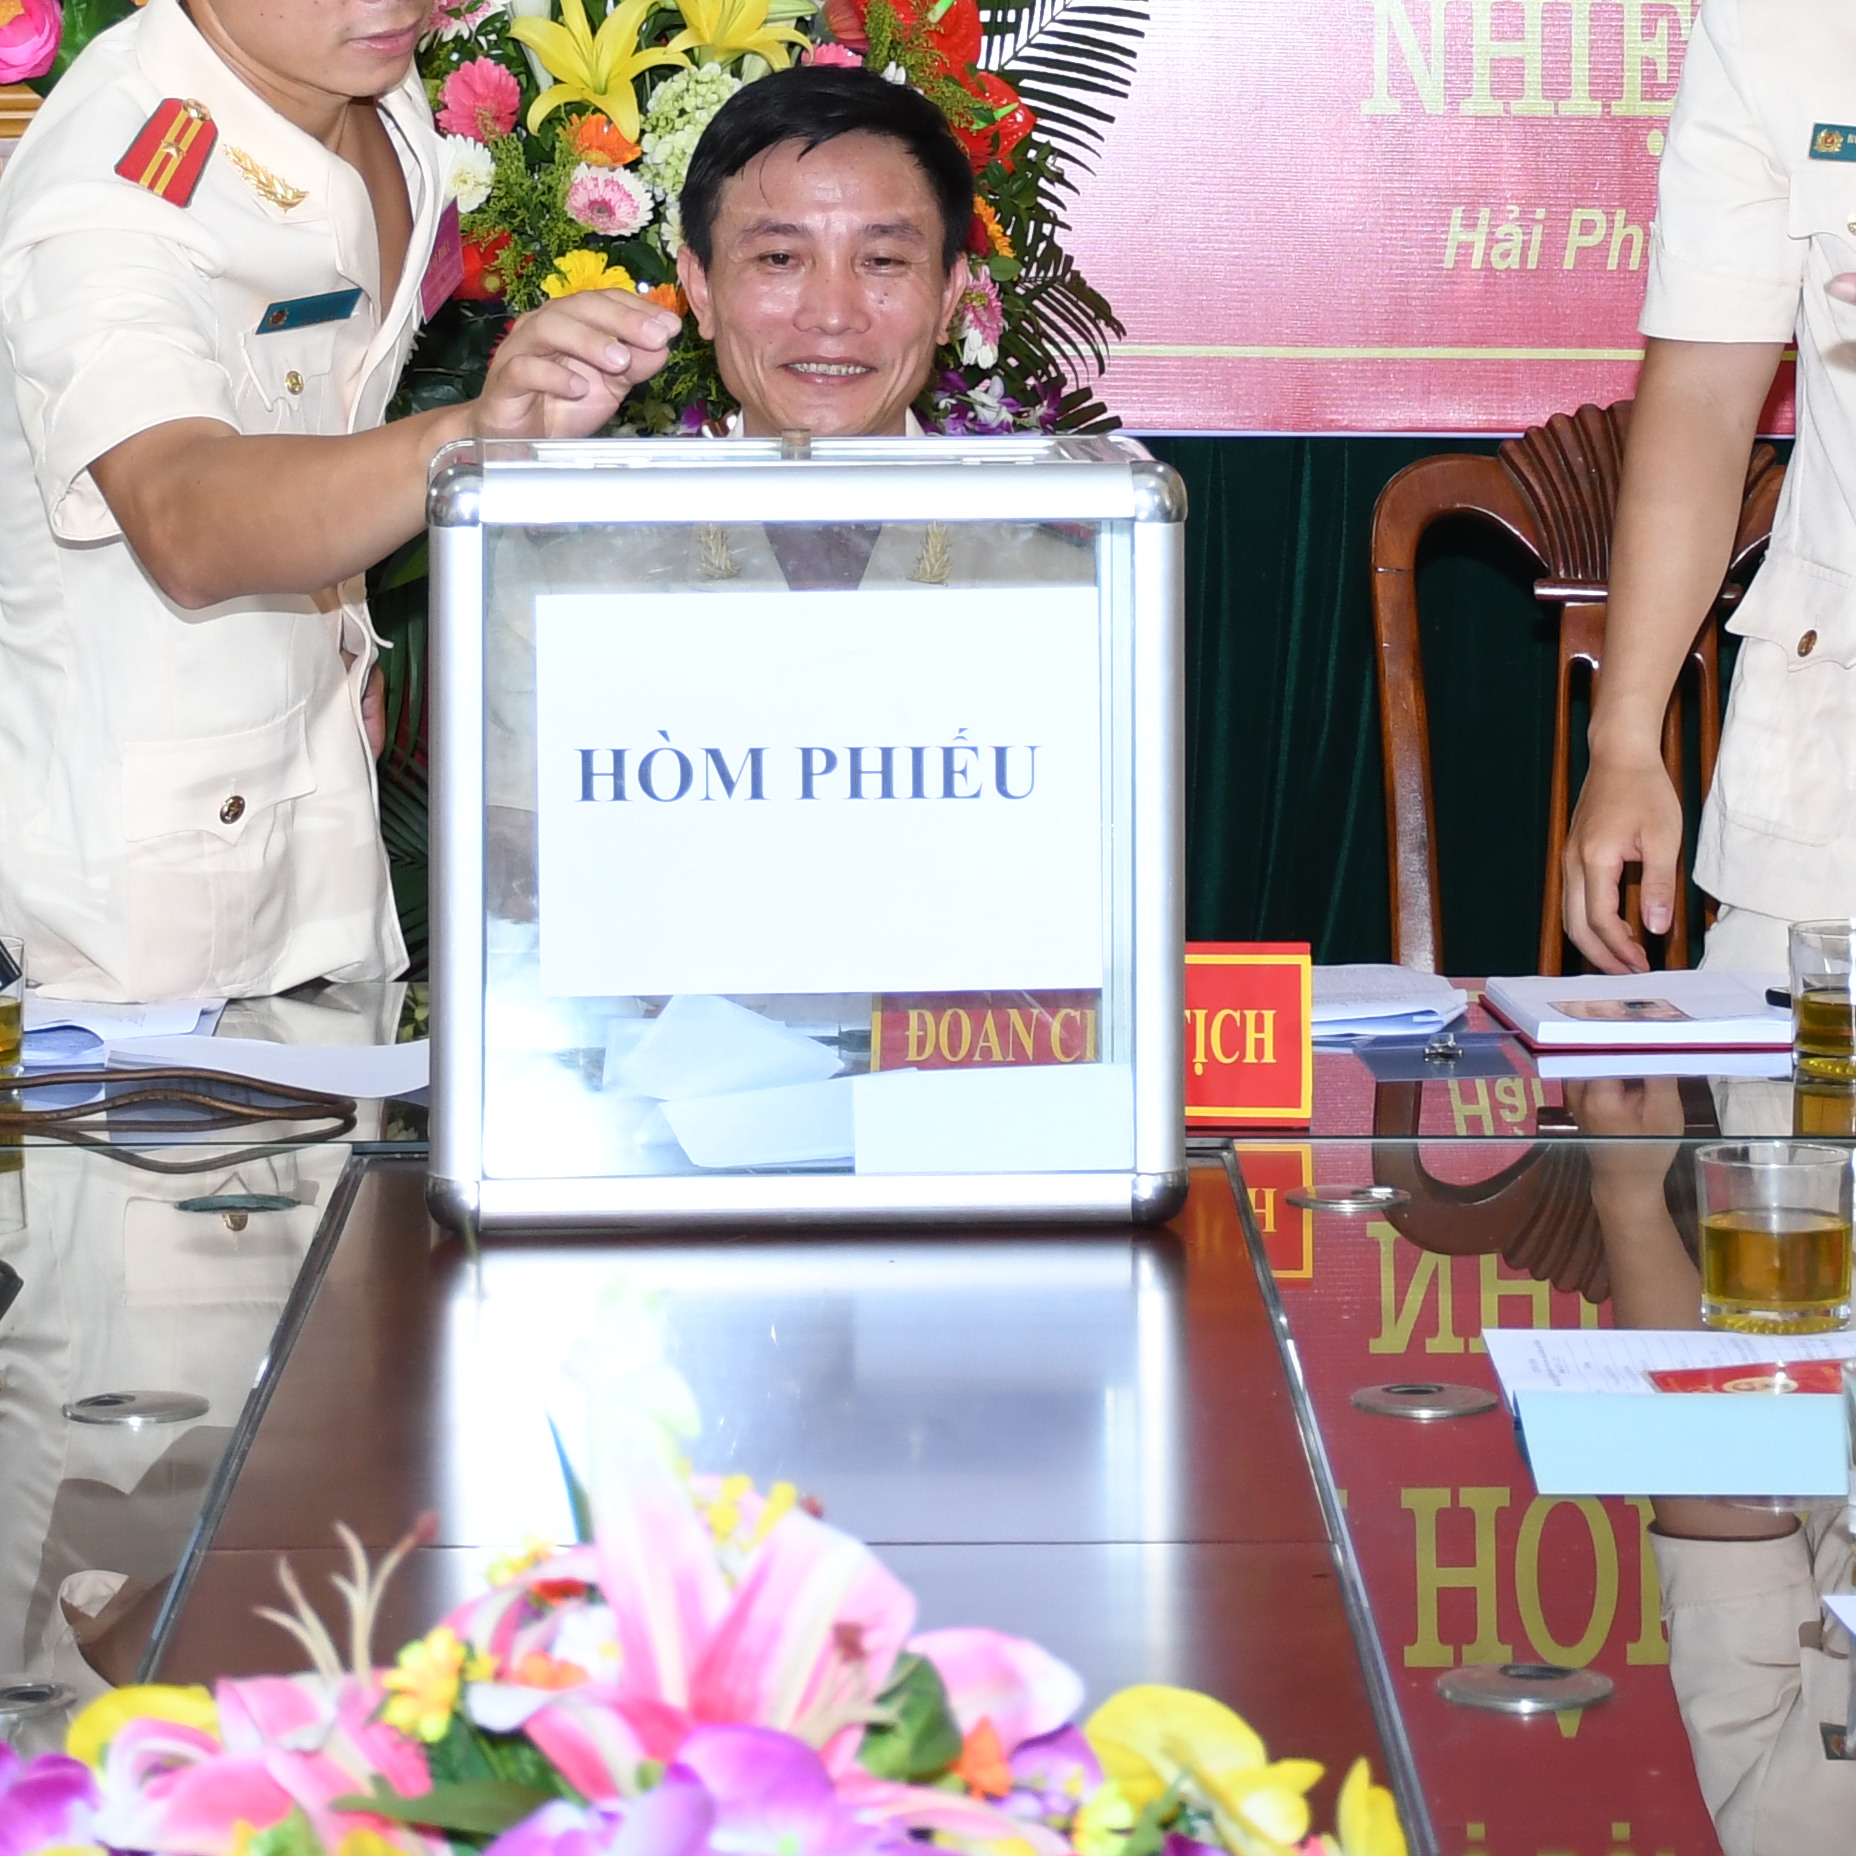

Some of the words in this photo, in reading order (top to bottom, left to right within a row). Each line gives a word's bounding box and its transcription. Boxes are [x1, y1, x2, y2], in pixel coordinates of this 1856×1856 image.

[1443, 204, 1546, 271] Hải
[573, 729, 771, 803] HÒM
[794, 727, 1042, 801] PHIẾU
[1185, 1008, 1277, 1076] ỊCH
